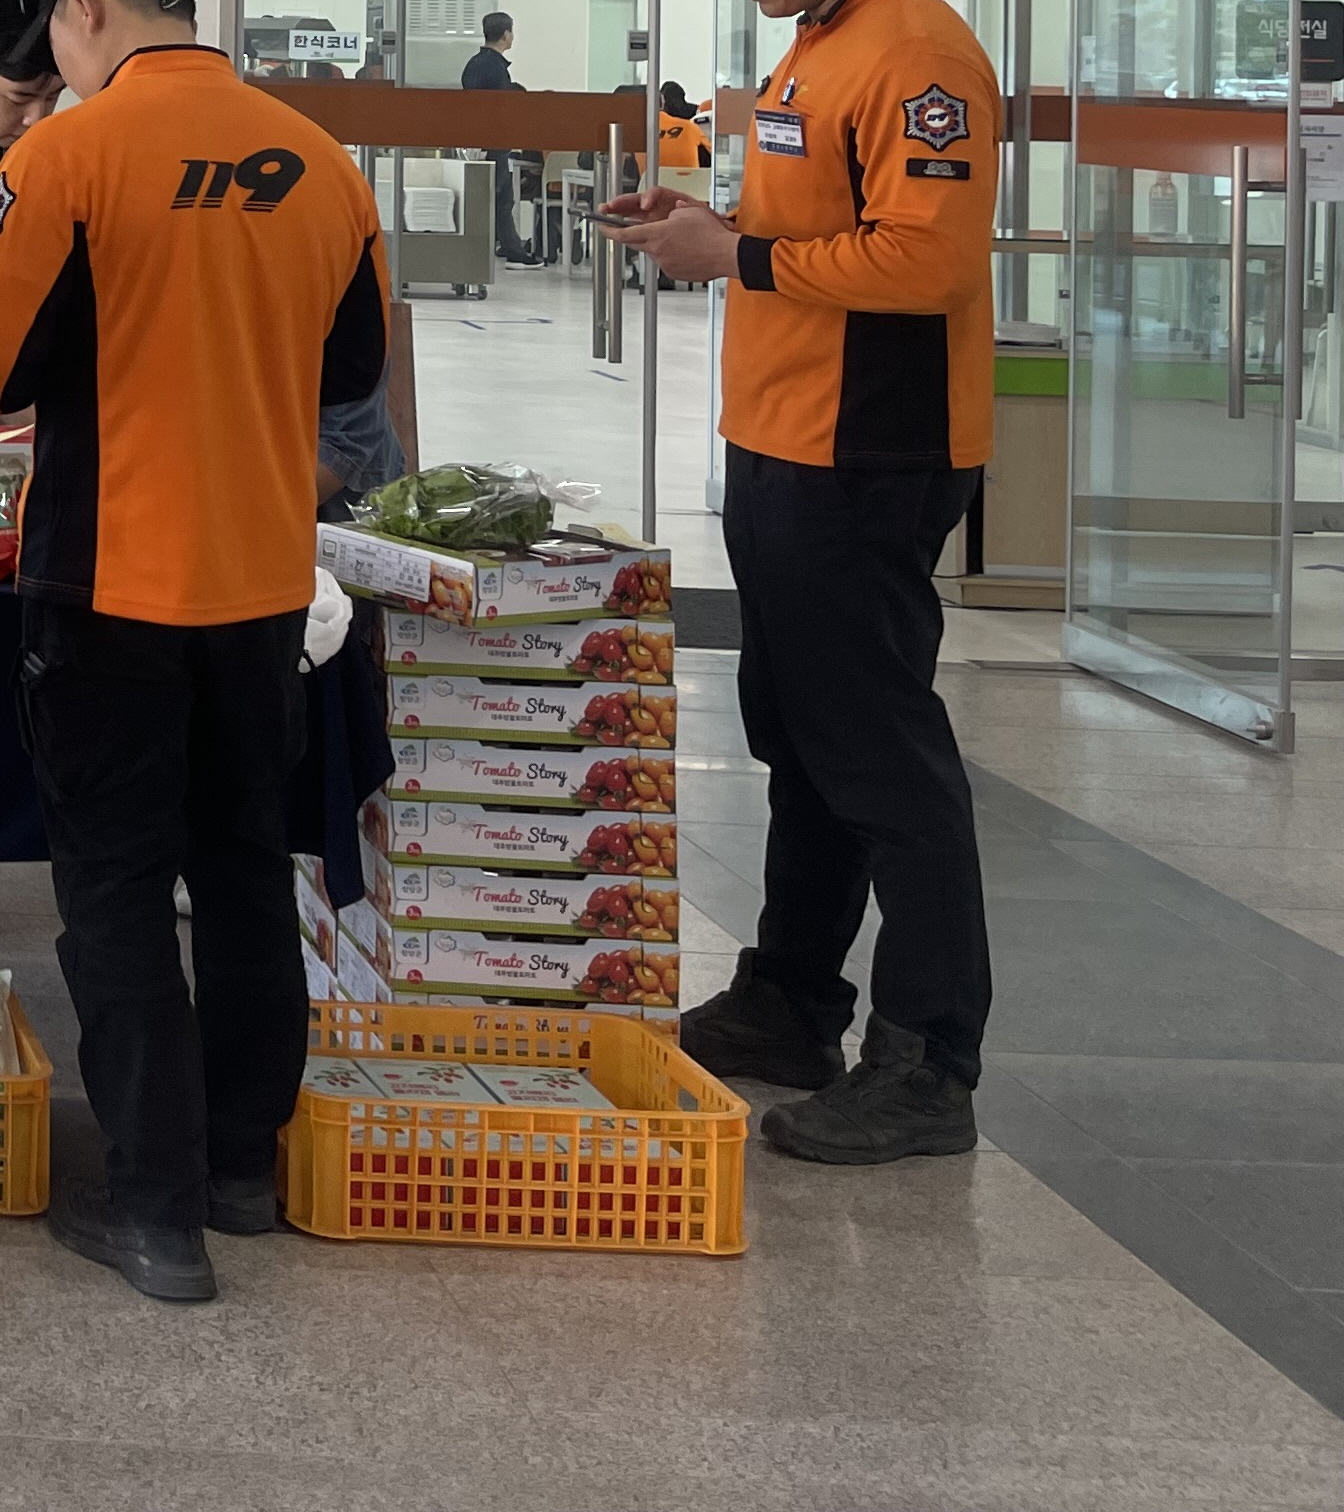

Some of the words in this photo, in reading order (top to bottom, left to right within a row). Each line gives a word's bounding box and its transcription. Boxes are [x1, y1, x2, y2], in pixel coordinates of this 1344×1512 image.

[293, 35, 358, 50] 한식코너
[170, 147, 306, 213] 119
[536, 577, 570, 595] Tomato
[573, 575, 601, 597] Story
[468, 631, 518, 649] Tomato
[522, 634, 563, 658] Story
[472, 695, 521, 712] Tomato
[525, 697, 567, 721] Story
[472, 760, 521, 777] Tomato
[527, 763, 568, 788] Story
[474, 823, 524, 841] Tomato
[527, 827, 569, 851] Story
[473, 886, 522, 903] Tomato
[527, 889, 569, 914] Story
[474, 951, 525, 969] Tomato
[528, 954, 570, 978] Story
